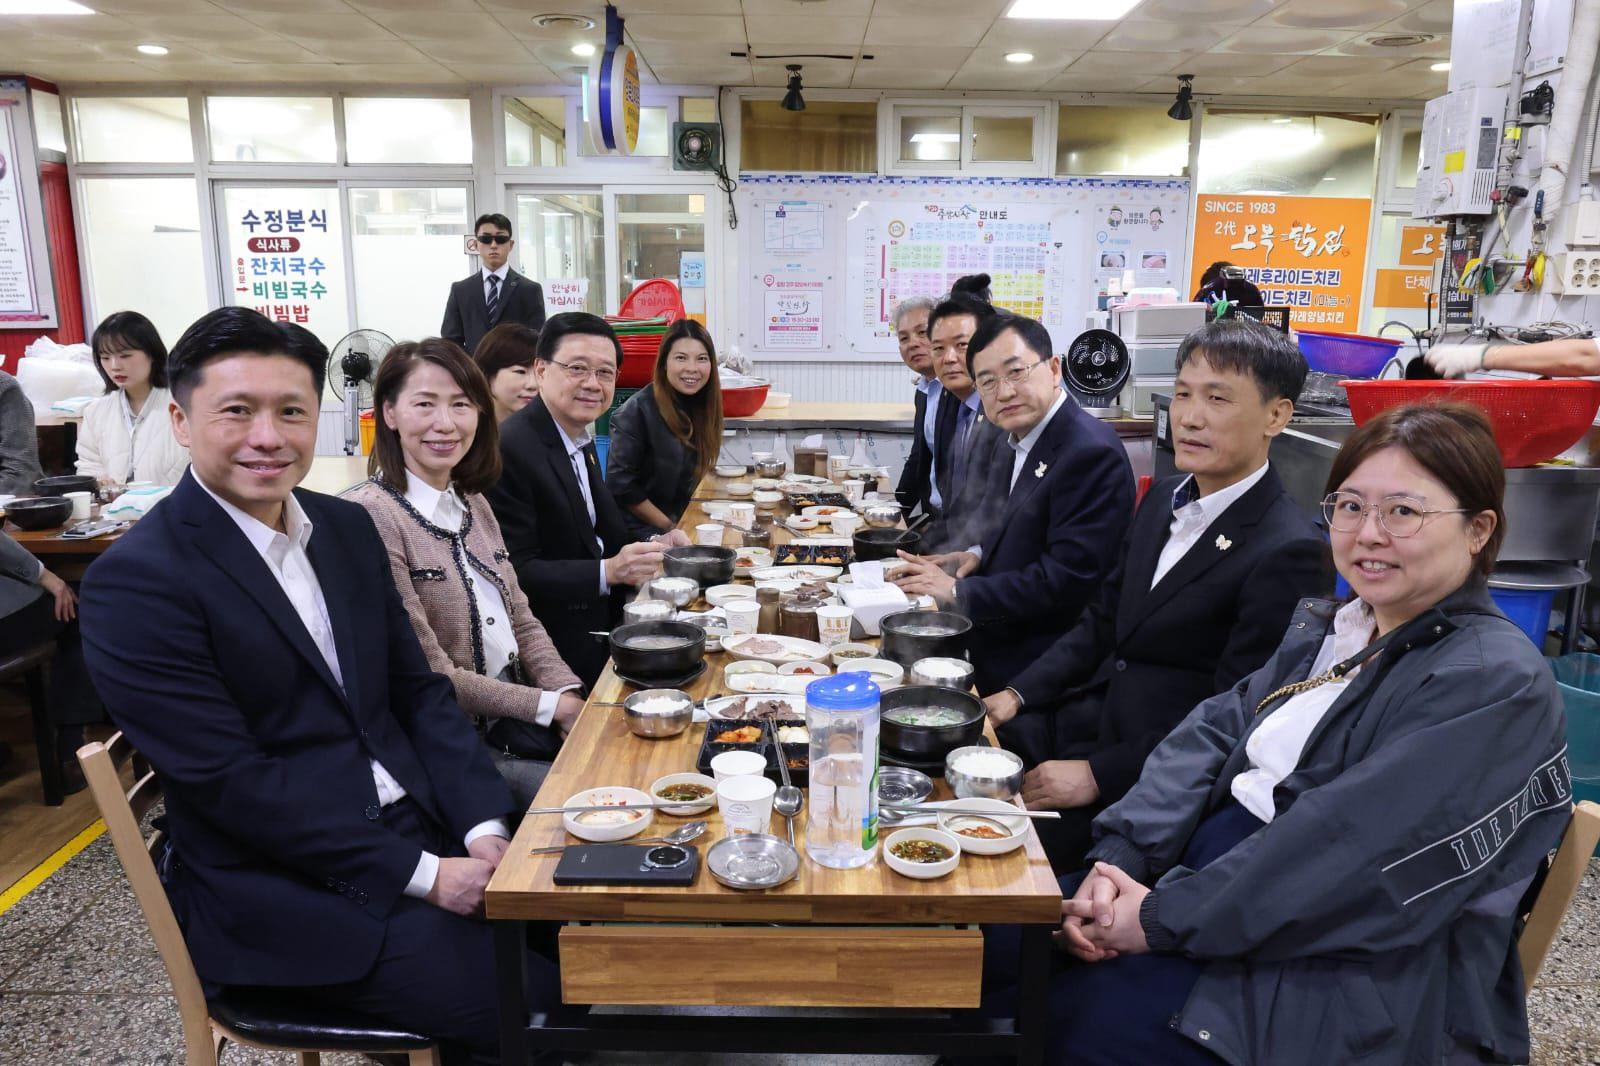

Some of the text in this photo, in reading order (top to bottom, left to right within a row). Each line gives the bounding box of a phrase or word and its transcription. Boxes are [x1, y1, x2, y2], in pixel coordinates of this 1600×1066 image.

[979, 210, 1008, 220] 안내도
[1205, 201, 1276, 214] SINCE 1983
[241, 209, 327, 233] 수정분식
[256, 238, 292, 252] 식사류
[250, 257, 326, 276] 잔치국수
[253, 281, 327, 299] 비빔국수
[1261, 290, 1311, 306] 이드치킨
[255, 304, 310, 323] 비빔밥
[1451, 816, 1502, 871] THE
